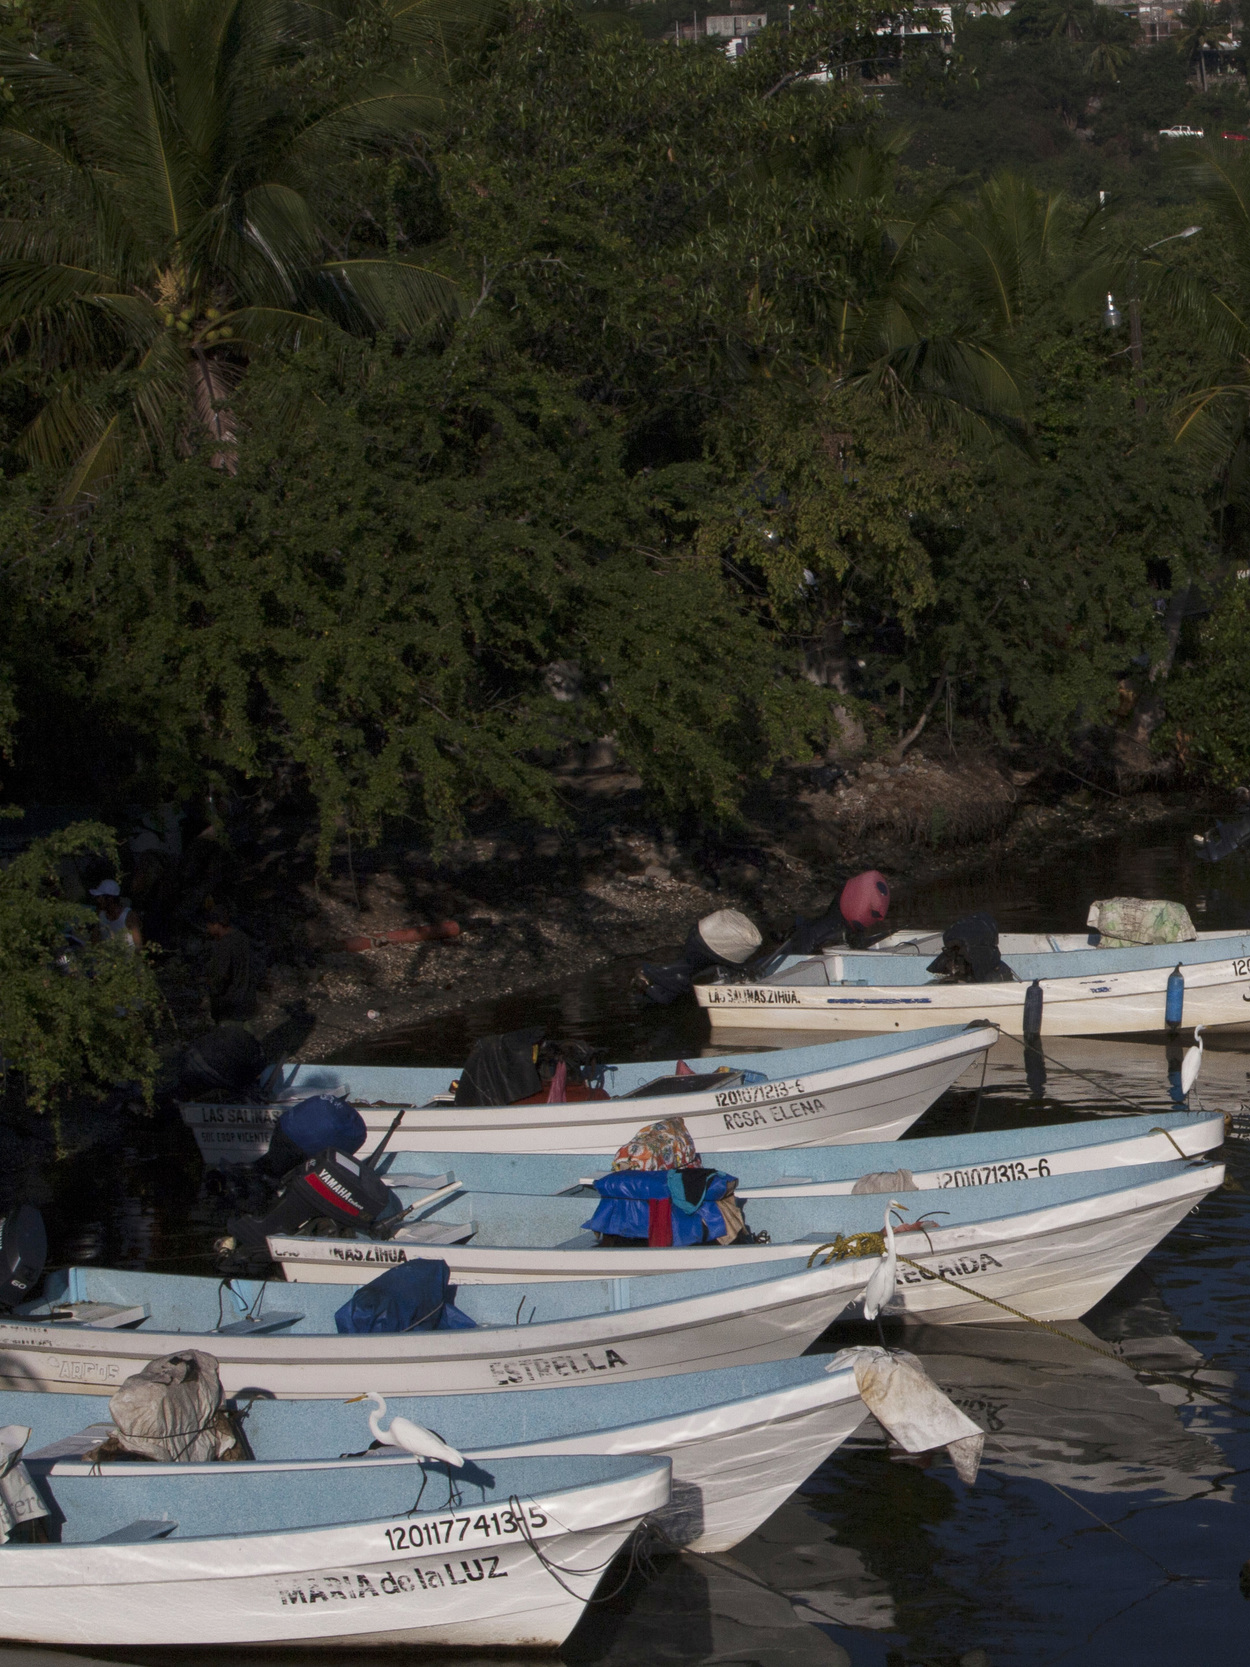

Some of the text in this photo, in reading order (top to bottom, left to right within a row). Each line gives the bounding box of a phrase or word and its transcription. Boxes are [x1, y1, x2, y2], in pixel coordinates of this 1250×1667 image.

[202, 1108, 224, 1123] LAS
[770, 1098, 826, 1122] ELENA
[237, 1131, 270, 1143] VICENTE
[319, 1168, 352, 1200] YAMAHA
[11, 1280, 27, 1290] 60
[489, 1349, 629, 1386] ESTRELLA
[384, 1506, 548, 1550] 1201177413-5
[276, 1573, 379, 1606] MARIA
[444, 1555, 508, 1586] LUZ
